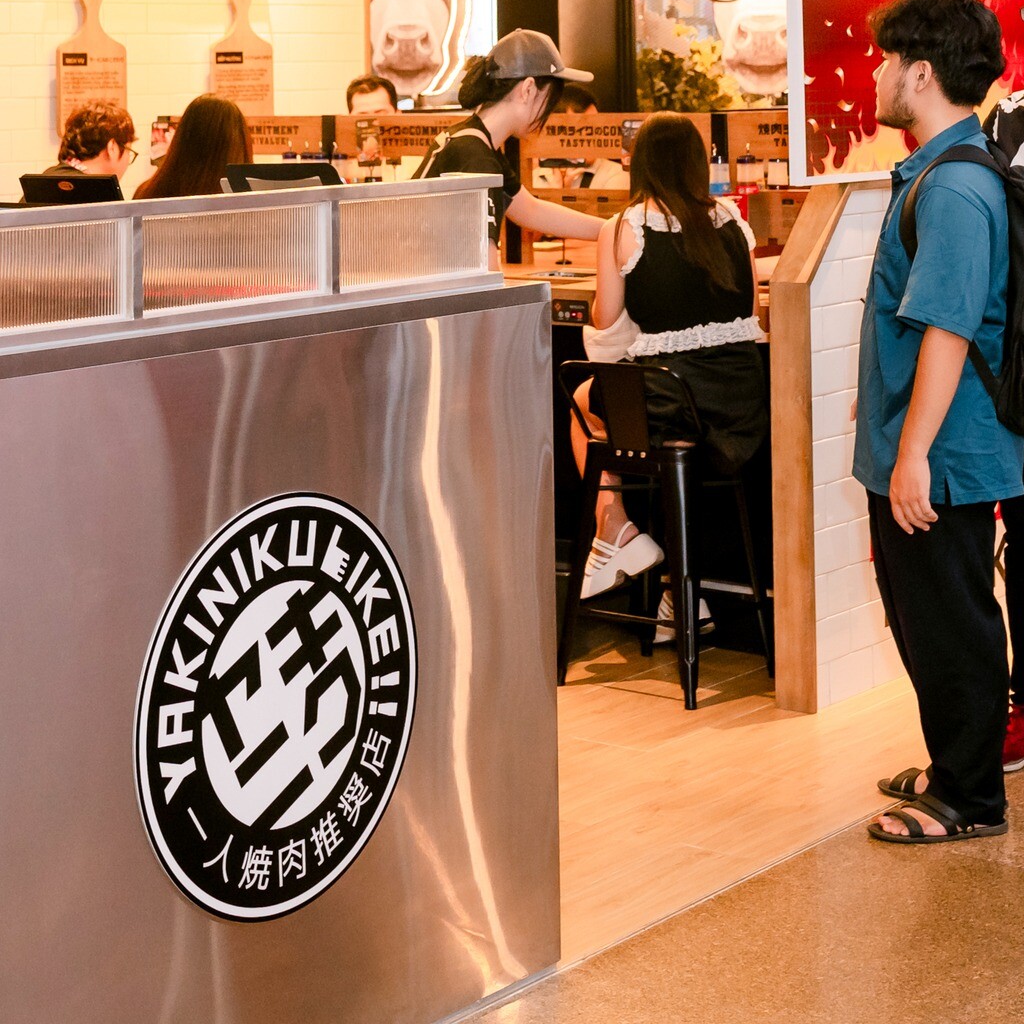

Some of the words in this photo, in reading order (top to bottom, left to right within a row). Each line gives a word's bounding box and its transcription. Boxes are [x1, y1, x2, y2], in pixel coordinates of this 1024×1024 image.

[248, 125, 299, 135] MMITMENT
[157, 519, 317, 805] YAKINIKU
[187, 727, 393, 891] 一人焼肉推奨店
